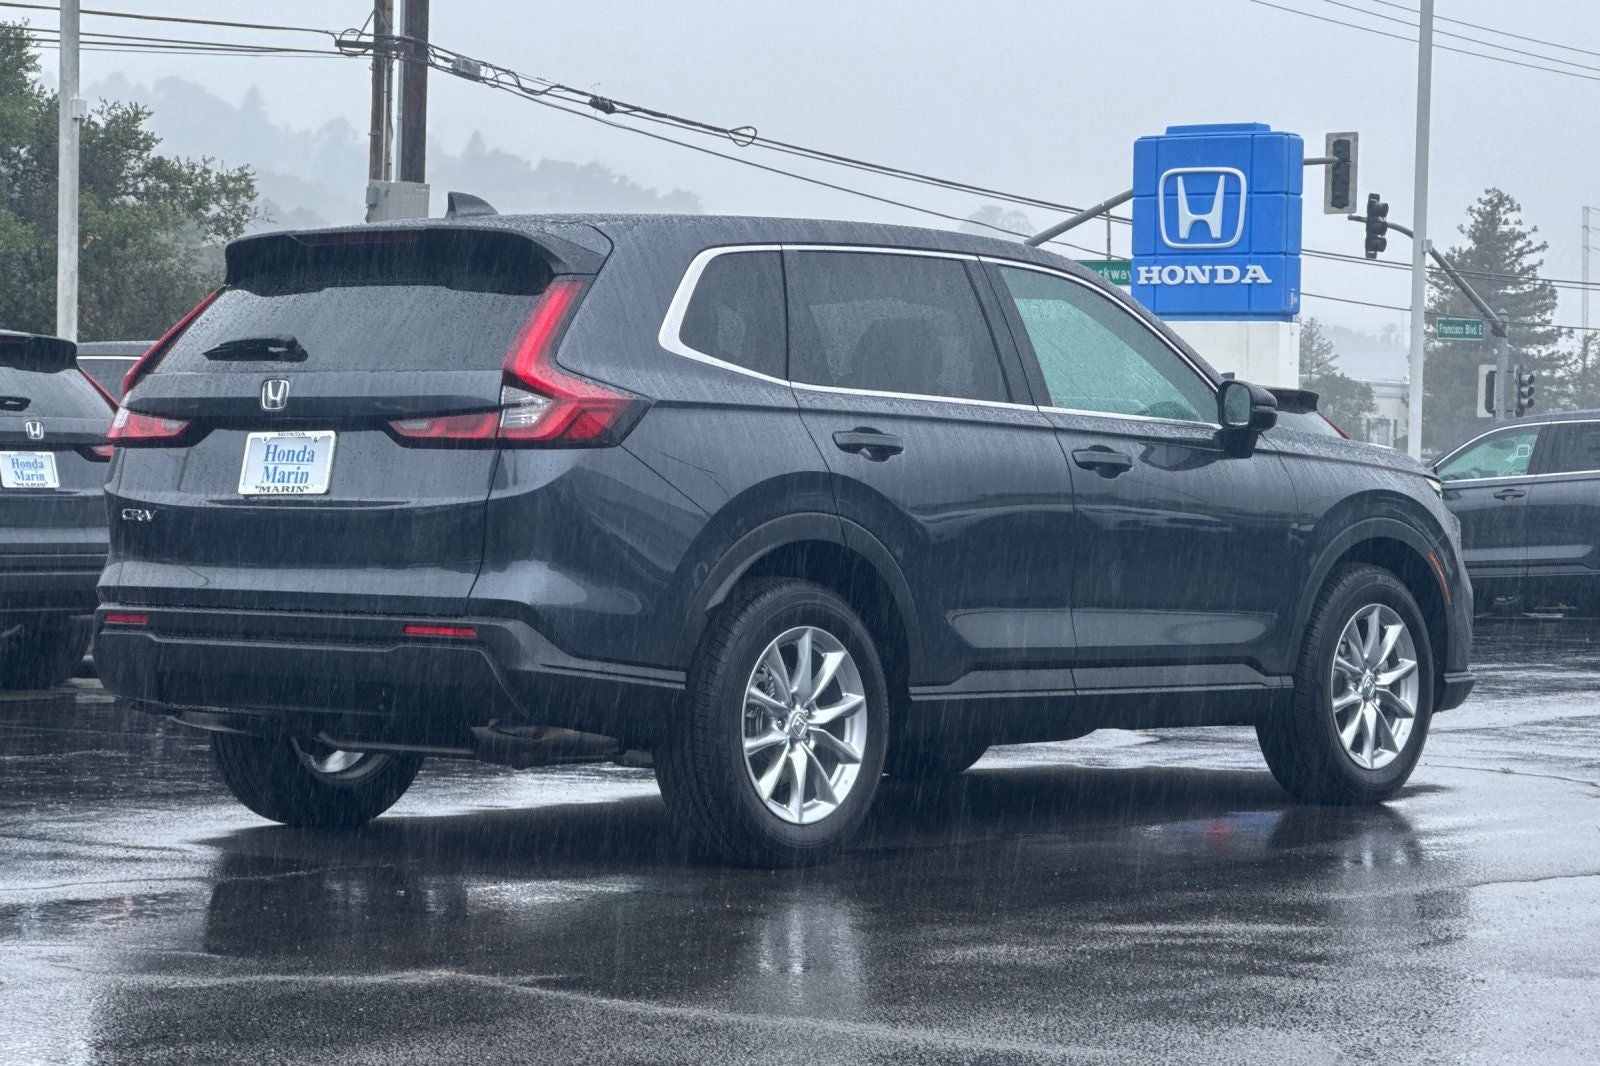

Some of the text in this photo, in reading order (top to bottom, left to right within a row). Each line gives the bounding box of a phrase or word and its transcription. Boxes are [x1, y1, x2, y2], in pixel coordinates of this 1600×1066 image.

[1137, 265, 1273, 286] HONDA
[263, 444, 315, 463] Honda
[11, 458, 44, 469] Honda
[14, 470, 45, 481] Marin
[261, 466, 309, 484] Marin
